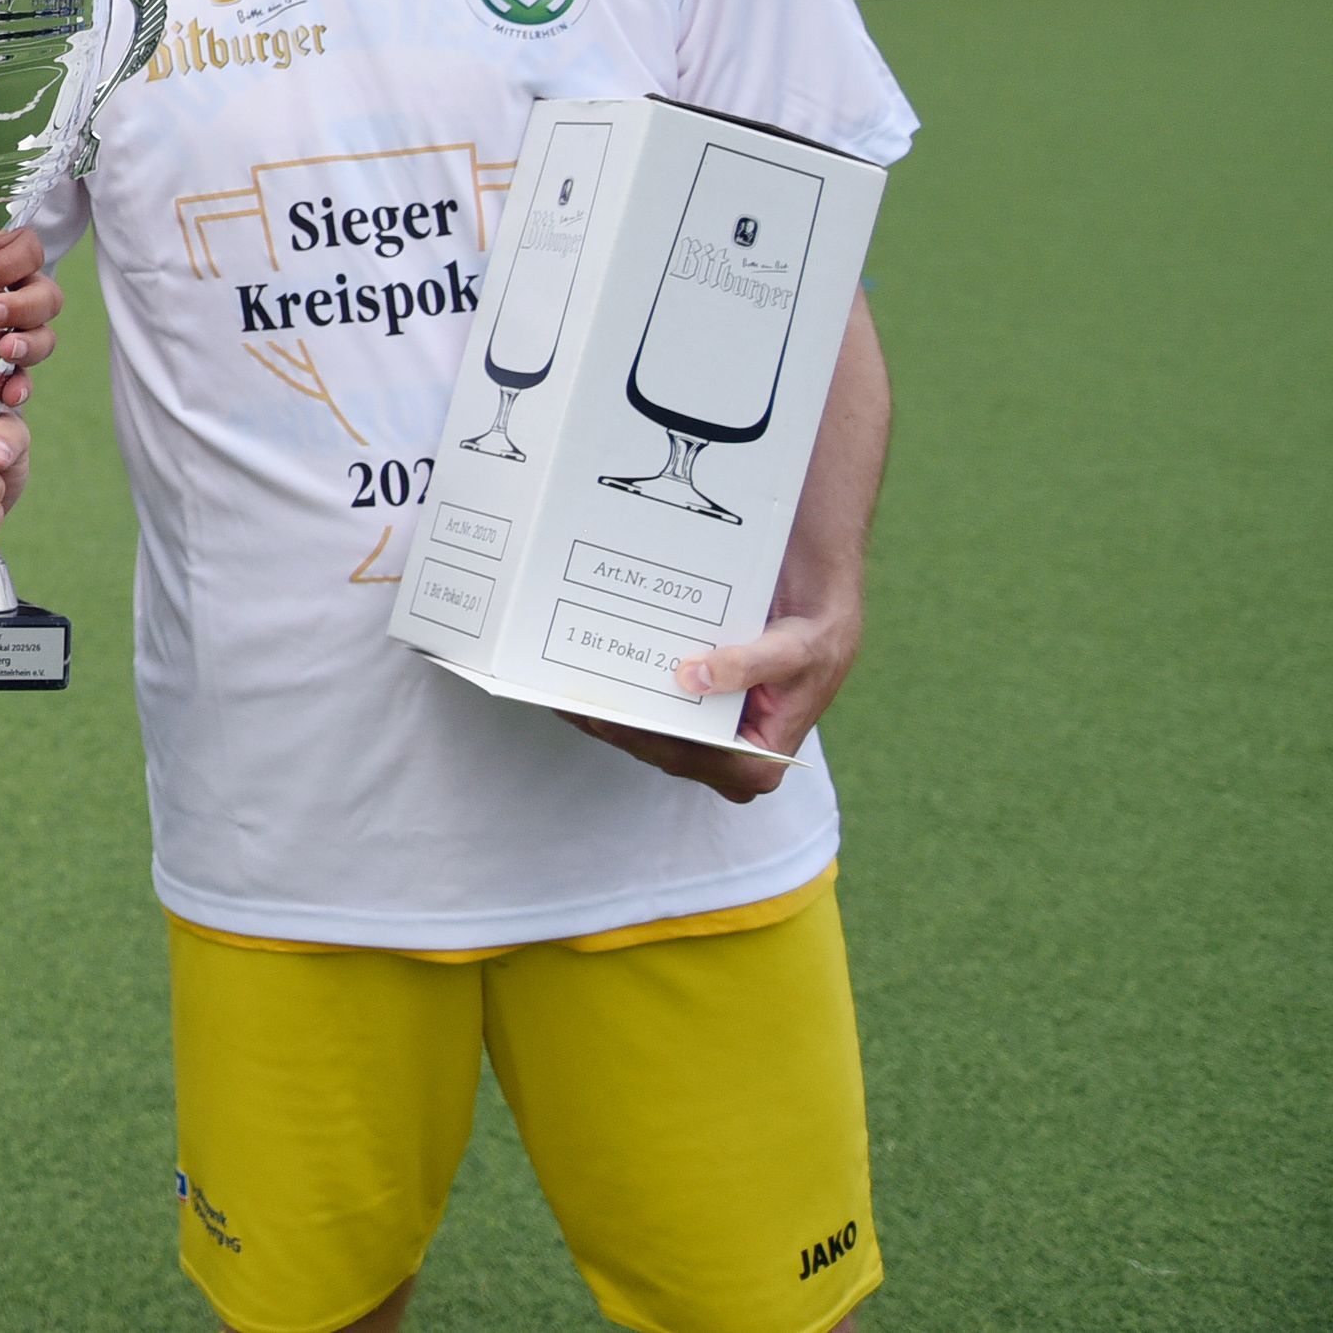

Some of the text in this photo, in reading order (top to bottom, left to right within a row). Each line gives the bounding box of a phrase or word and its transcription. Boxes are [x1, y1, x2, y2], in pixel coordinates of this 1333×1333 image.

[493, 23, 568, 40] MITTELRHEIN
[288, 197, 458, 258] Sieger
[235, 260, 479, 337] Kreispok
[669, 236, 793, 310] Bitburger
[348, 458, 435, 508] 202
[593, 561, 703, 604] Art.Nr. 20170
[566, 627, 681, 673] 1 Bit Pokal 2,0
[799, 1220, 857, 1281] JAKO
